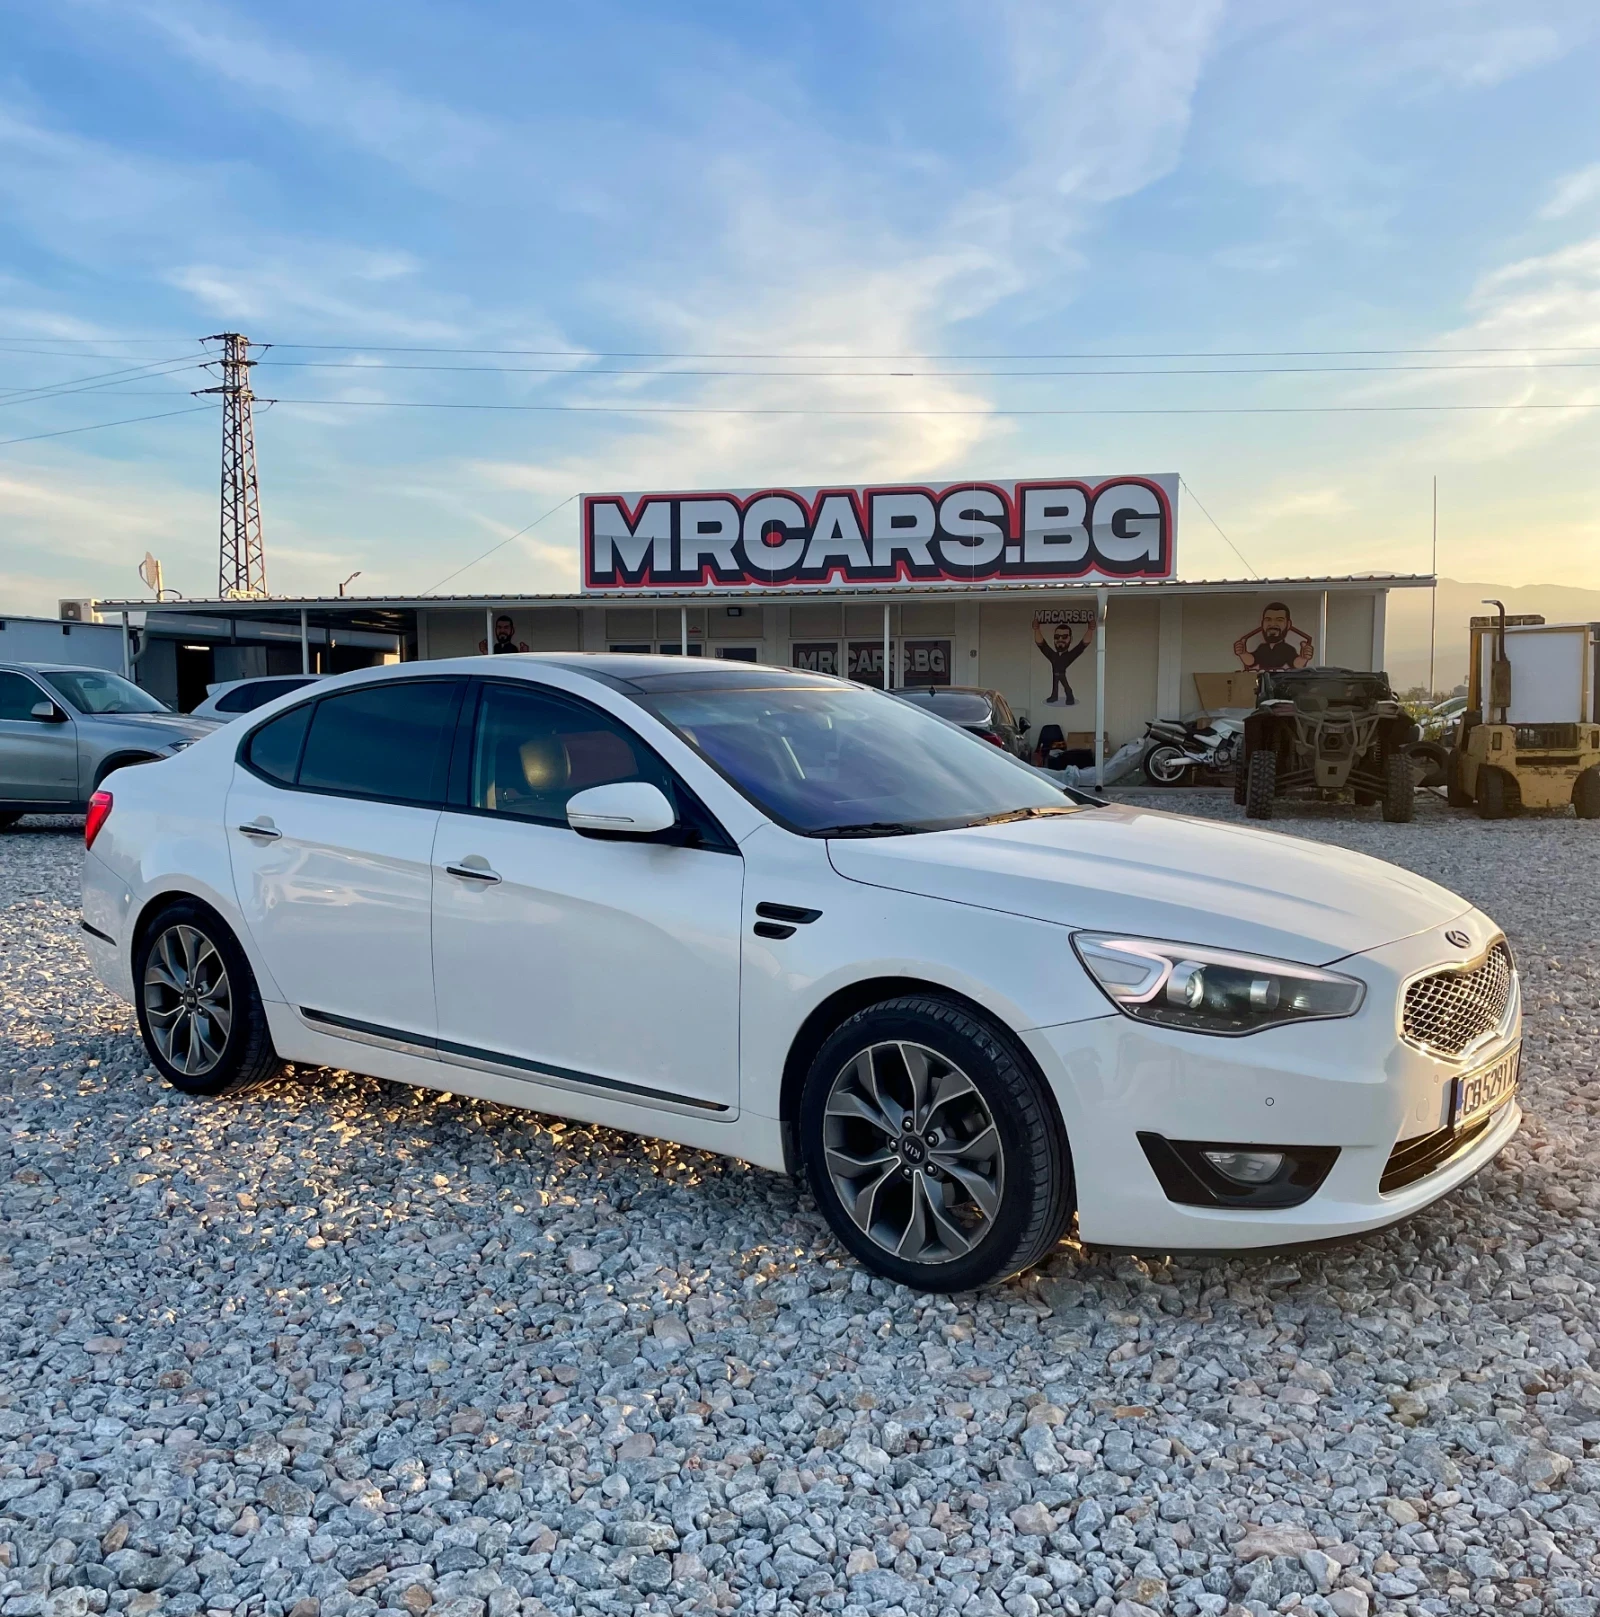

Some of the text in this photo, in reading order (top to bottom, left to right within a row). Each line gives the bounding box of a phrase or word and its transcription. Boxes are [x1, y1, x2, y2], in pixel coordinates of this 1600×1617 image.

[592, 482, 1162, 575] MRCARS.BG
[1035, 610, 1094, 623] MRCARS.BG
[904, 1142, 921, 1159] KIA
